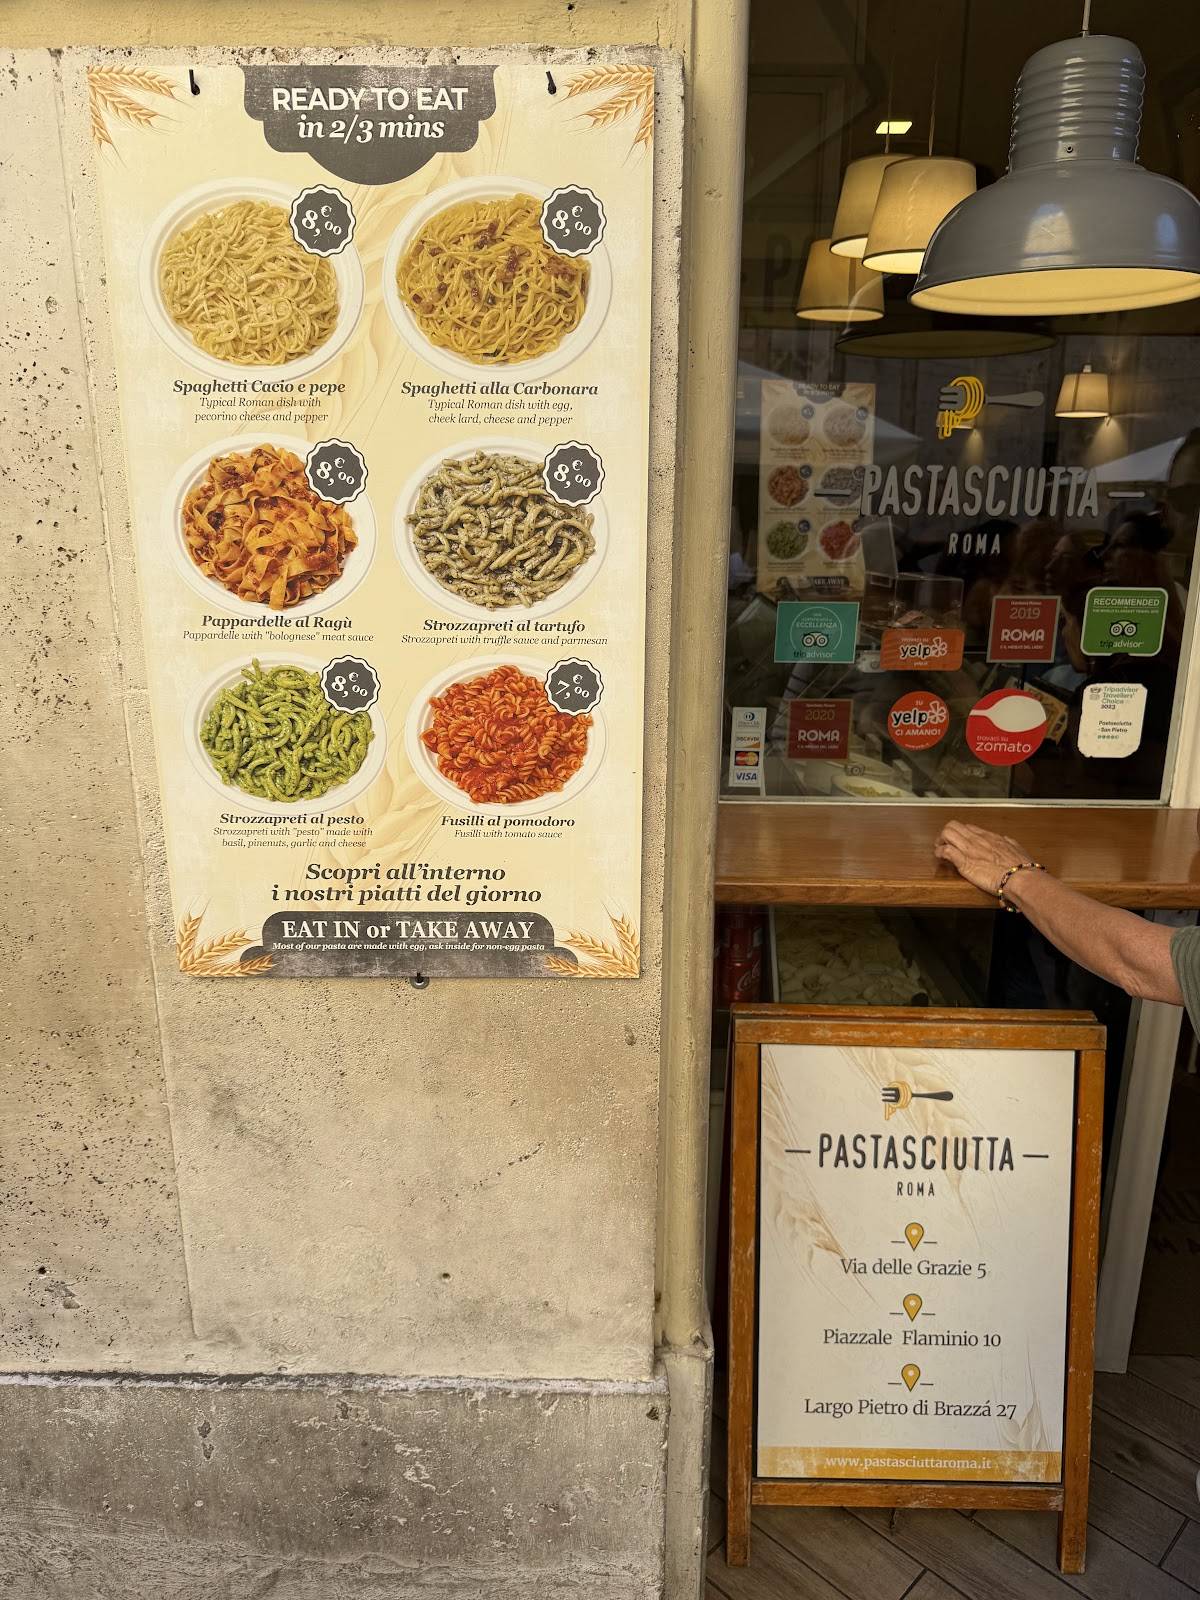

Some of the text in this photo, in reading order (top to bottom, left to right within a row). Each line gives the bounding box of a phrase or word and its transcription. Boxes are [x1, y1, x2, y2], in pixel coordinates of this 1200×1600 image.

[273, 88, 468, 110] READY TO EAT
[298, 114, 444, 144] in 2/3 mins
[173, 380, 345, 395] Spaghetti Cacio e pepe
[401, 382, 598, 397] Spaghetti alla Carbonara
[200, 398, 321, 408] Typical Roman dish with
[428, 399, 573, 412] Typical Roman dish with egg,
[194, 411, 328, 423] pecorino cheese and pepper
[429, 414, 573, 426] cheek lard, cheese and pepper
[860, 464, 1098, 517] PASTASCIUTTA
[948, 533, 1000, 554] ROMA
[1093, 598, 1160, 606] RECOMMENDED
[1010, 608, 1040, 620] 2019
[202, 616, 352, 631] Pappardelle al Ragù
[423, 619, 585, 634] Strozzapreti al tartufo
[183, 631, 239, 641] Pappardelle
[242, 632, 262, 640] with
[266, 632, 320, 642] "bolognese"
[348, 634, 374, 642] sauce
[402, 635, 458, 645] Strozzapreti
[460, 635, 480, 644] with
[483, 636, 511, 646] truffle
[541, 636, 559, 645] and
[561, 638, 607, 646] parmesan
[1000, 628, 1044, 642] ROMA
[1100, 640, 1142, 649] tripadvisor
[900, 643, 931, 660] yelp
[892, 708, 928, 728] yelp
[798, 730, 840, 742] ROMA
[976, 741, 1032, 754] zomato
[736, 772, 758, 780] VISA
[220, 813, 364, 826] Strozzapreti al pesto
[442, 816, 575, 828] Fusilli al pomodoro
[214, 828, 268, 837] Strozzapreti
[326, 828, 350, 836] made
[354, 828, 373, 836] with
[455, 830, 481, 838] Fusilli
[484, 830, 502, 838] with
[505, 830, 536, 838] tomato
[223, 839, 245, 848] basil,
[248, 839, 289, 848] pinenuts,
[291, 840, 317, 848] garlic
[306, 864, 380, 883] Scopri
[272, 885, 541, 905] i nostri piatti del giorno
[282, 921, 534, 938] EAT IN or TAKE AWAY
[296, 942, 306, 951] of
[322, 943, 346, 951] pasta
[470, 943, 486, 951] for
[819, 1134, 1014, 1171] PASTASCIUTTA
[897, 1182, 935, 1196] ROMA
[841, 1259, 986, 1278] Via delle Grazie 5
[824, 1329, 1001, 1347] Piazzale Flaminio 10
[805, 1399, 1016, 1419] Largo Pietro di Brazzá 27
[825, 1457, 991, 1469] www.pastasciuttaroma.it
